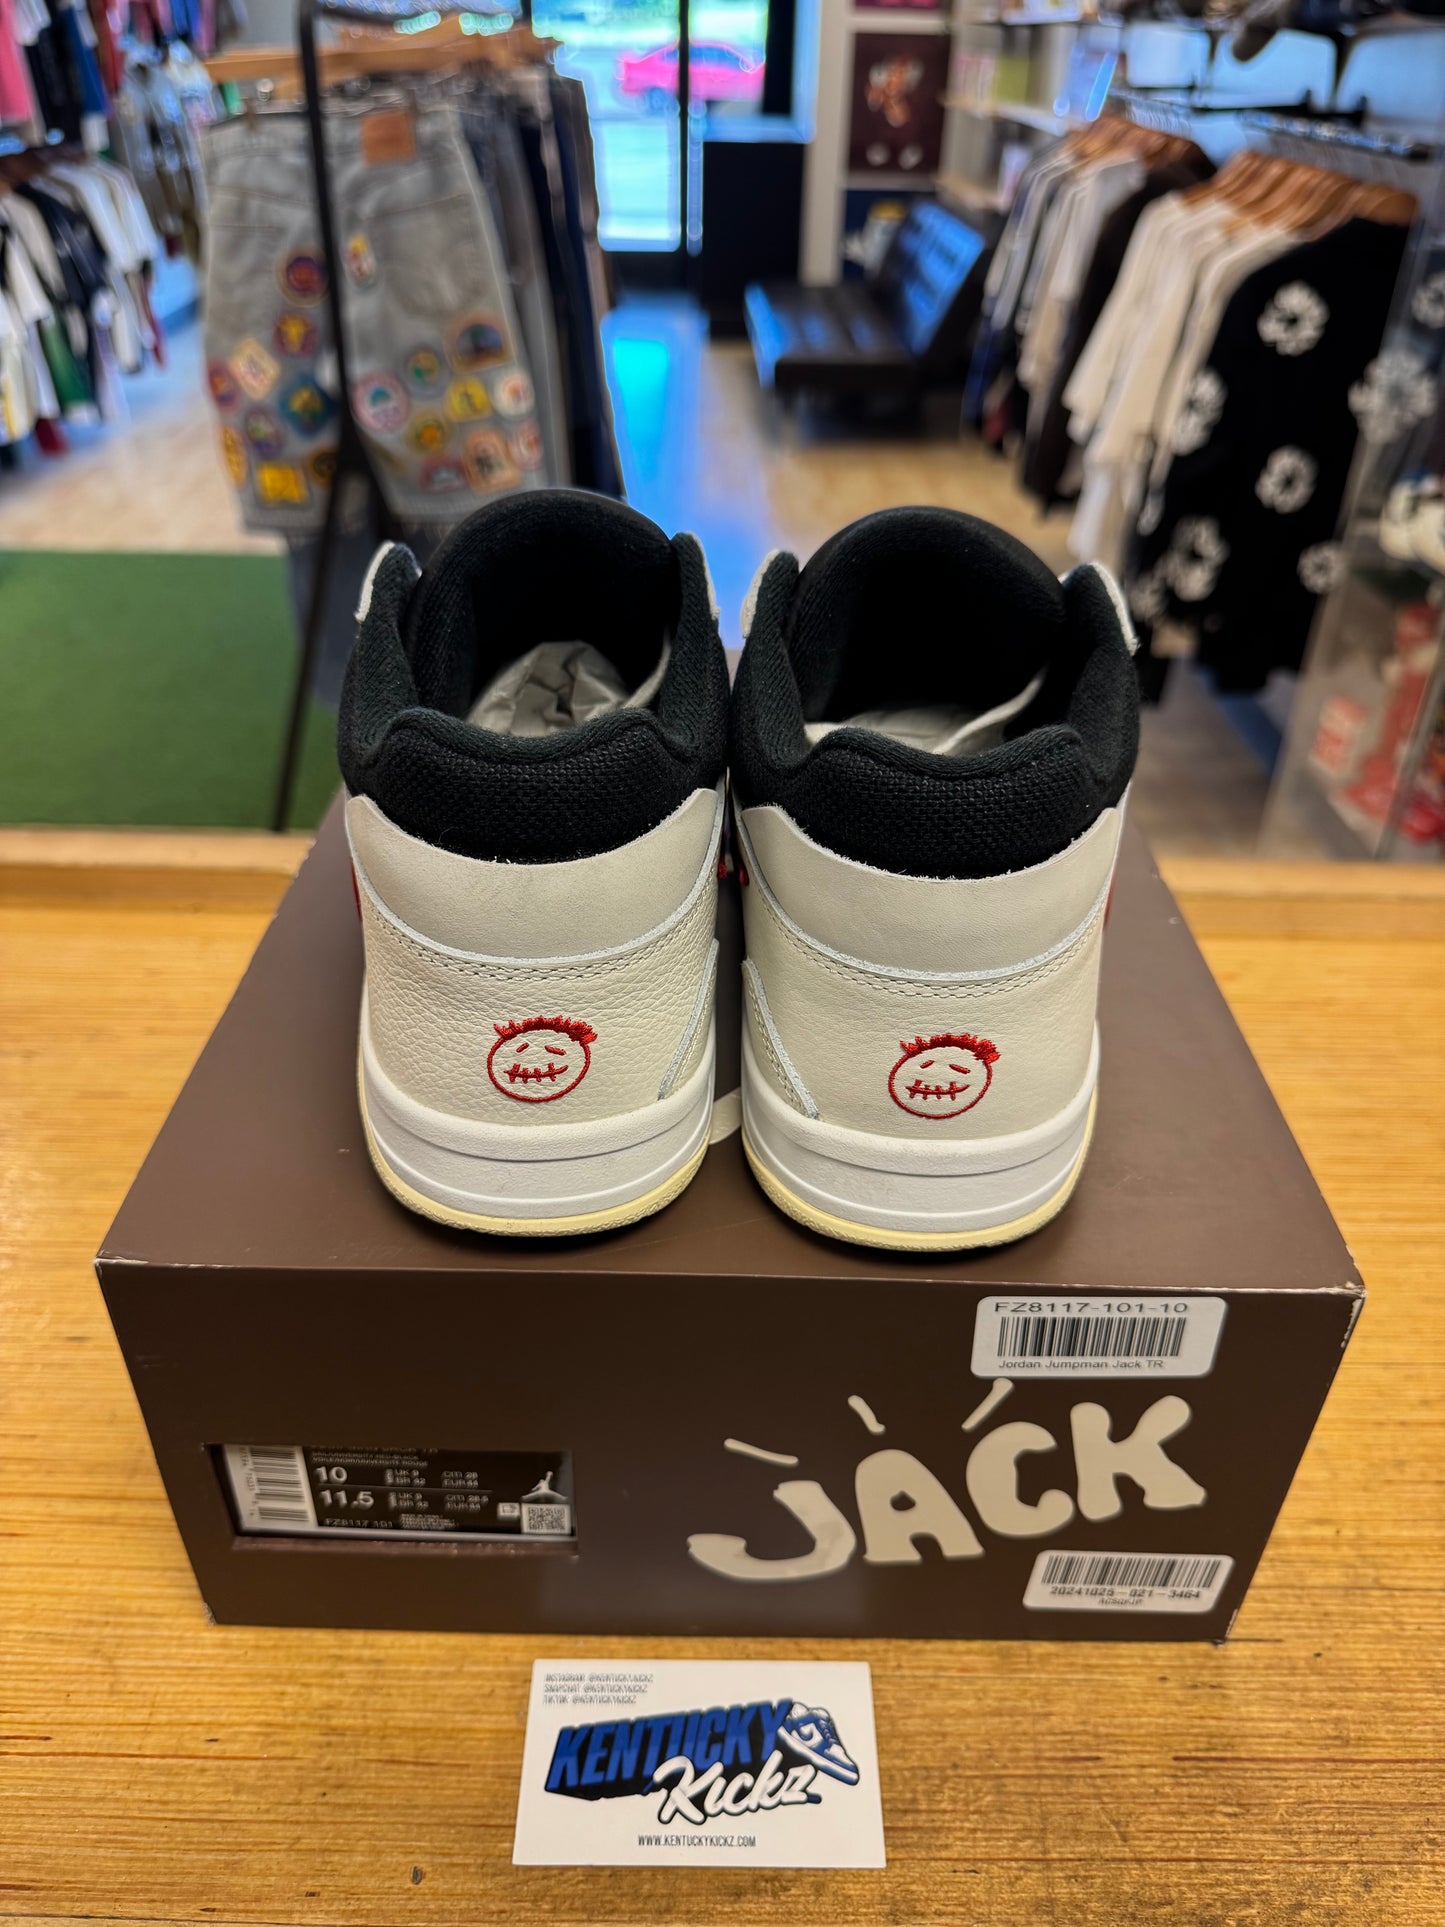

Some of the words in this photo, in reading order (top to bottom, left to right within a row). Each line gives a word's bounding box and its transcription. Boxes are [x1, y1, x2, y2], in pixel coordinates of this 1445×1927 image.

[995, 1302, 1188, 1313] FZ8117-101-10
[999, 1360, 1041, 1369] Jordan
[1046, 1360, 1108, 1370] Jumpman
[1112, 1360, 1142, 1369] Jack
[1146, 1360, 1164, 1369] TR
[315, 1466, 348, 1484] 10
[687, 1395, 1206, 1581] JACK
[319, 1490, 375, 1509] 11.5
[545, 1698, 793, 1793] KENTUCKY
[652, 1750, 817, 1825] Kickz
[638, 1834, 756, 1847] WWW.KENTUCKYKICKZ.COM
